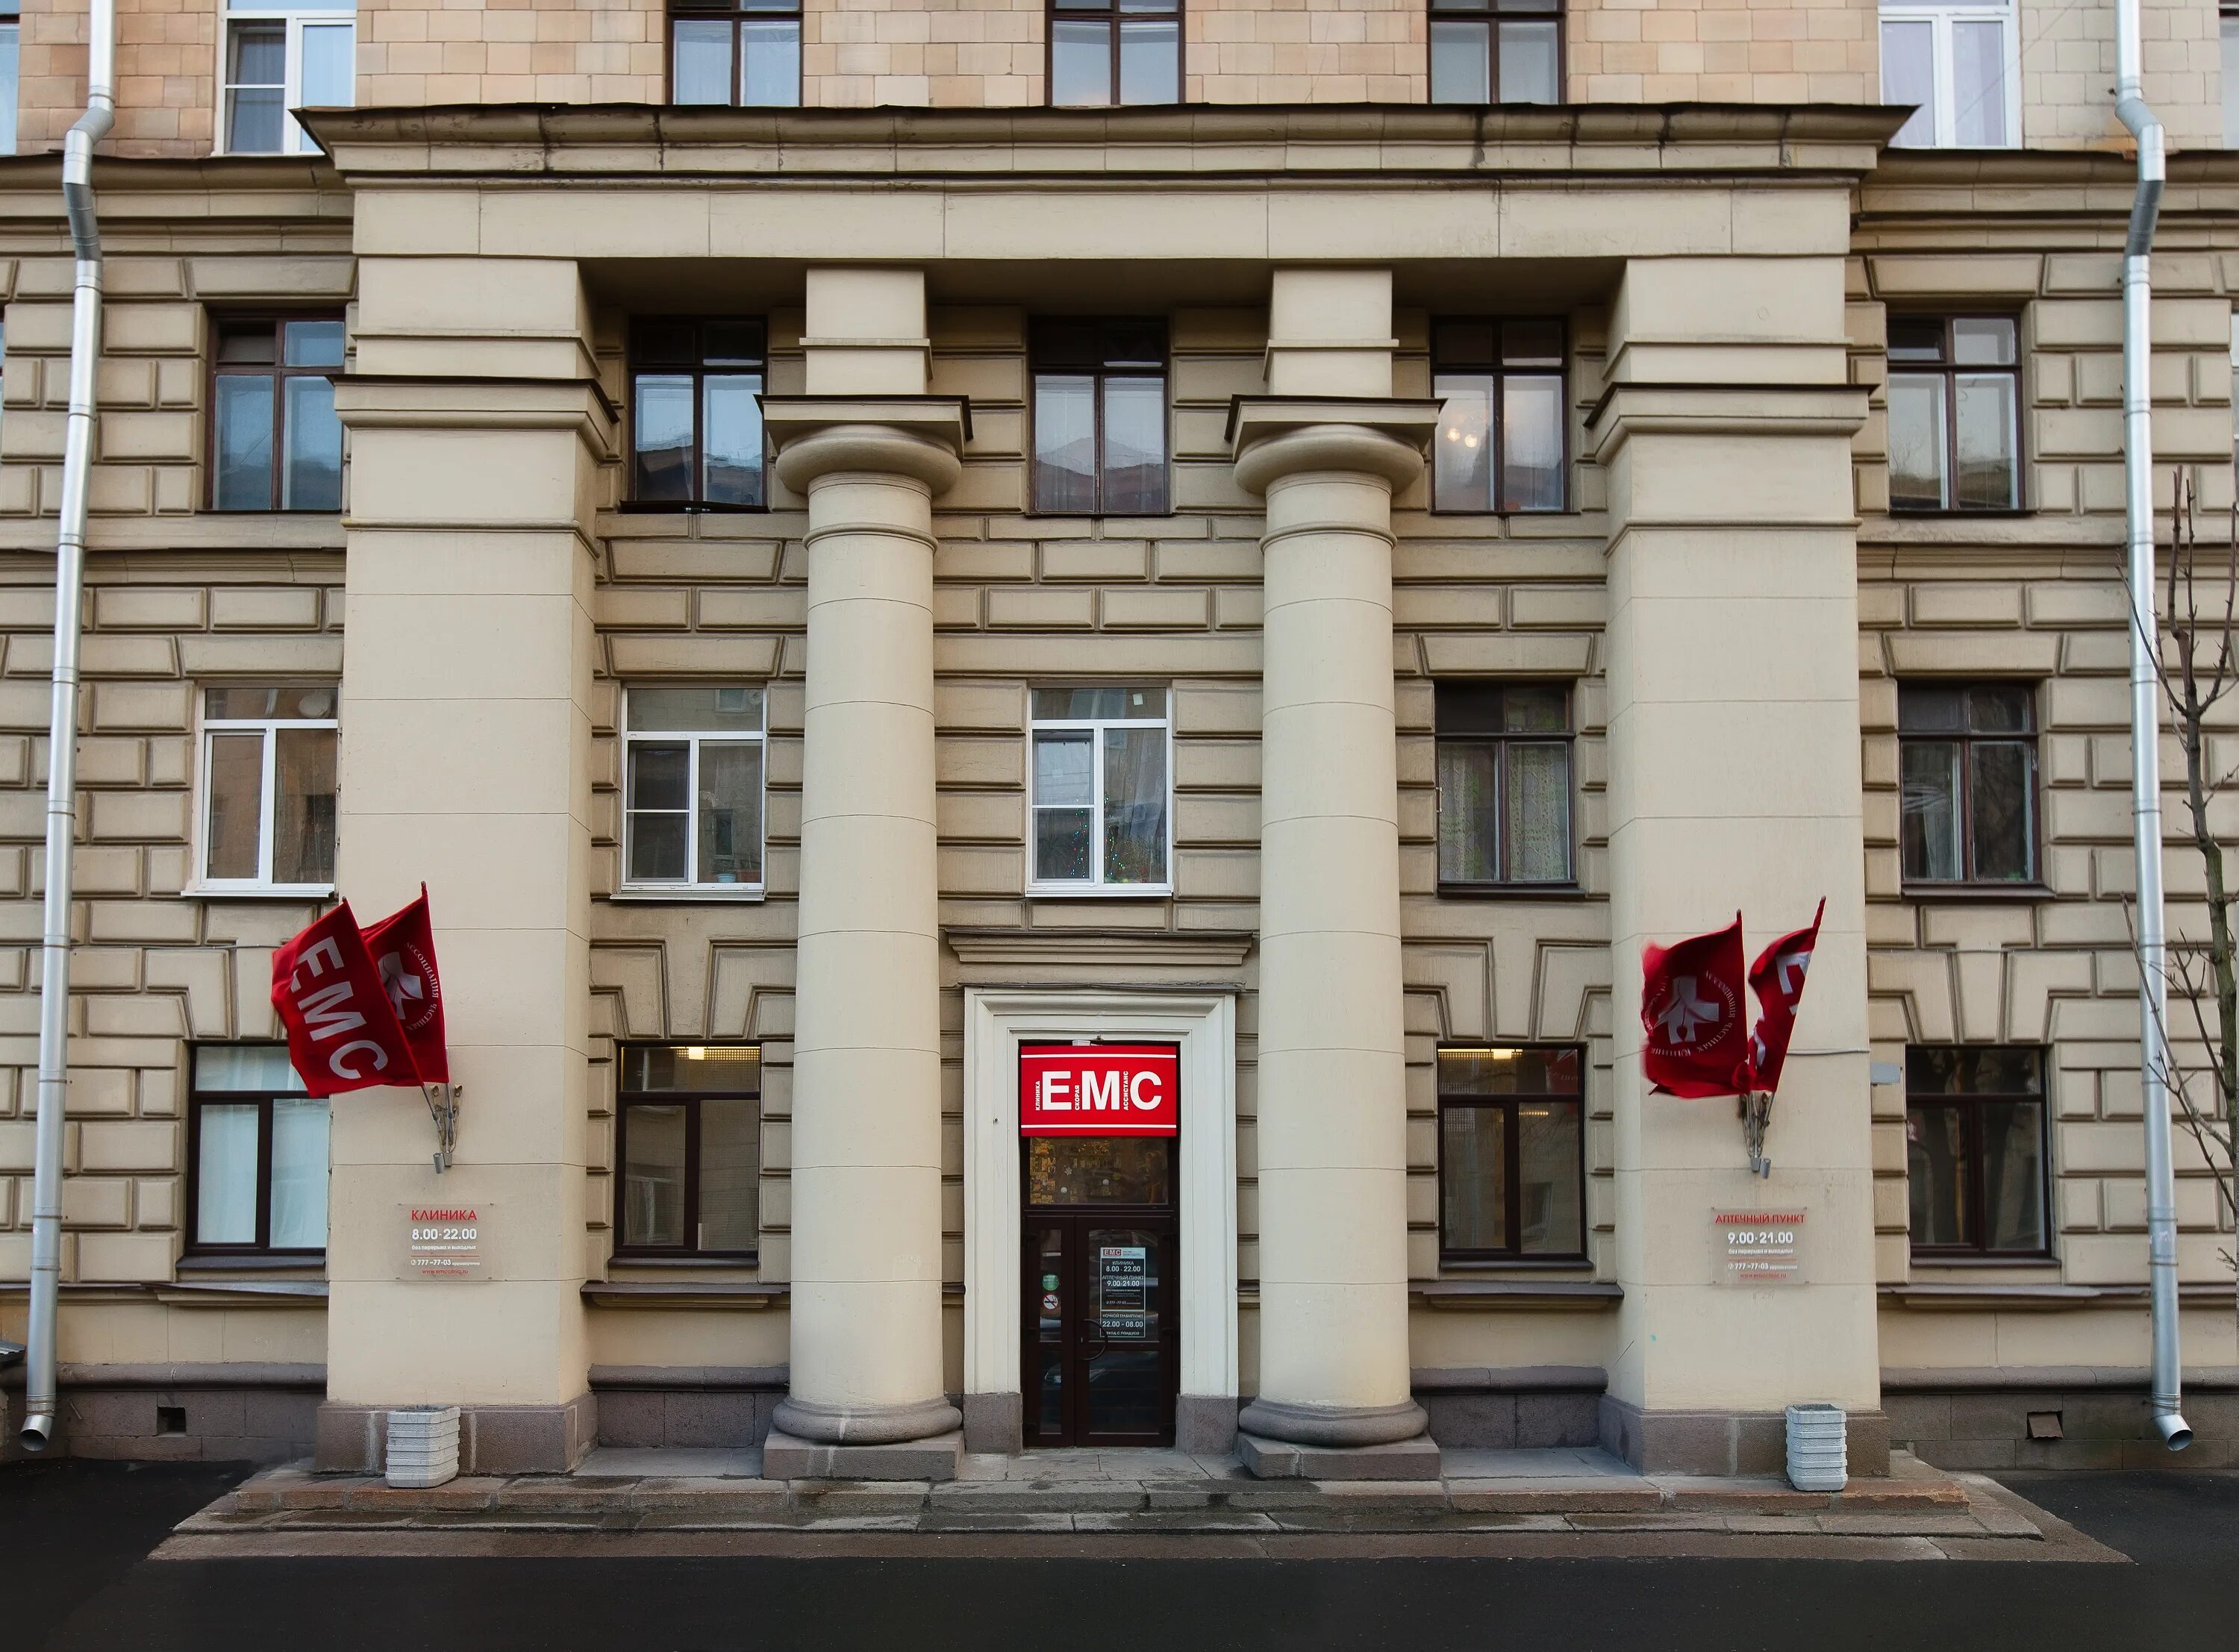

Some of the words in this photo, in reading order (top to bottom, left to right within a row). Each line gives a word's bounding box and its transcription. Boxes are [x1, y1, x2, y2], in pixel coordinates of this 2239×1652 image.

[290, 936, 388, 1079] EMC
[1042, 1071, 1162, 1110] EMC
[411, 1210, 478, 1221] КЛИНИКА
[1715, 1213, 1770, 1224] АПТЕЧНЫЙ
[1773, 1214, 1805, 1224] ПУНКТ
